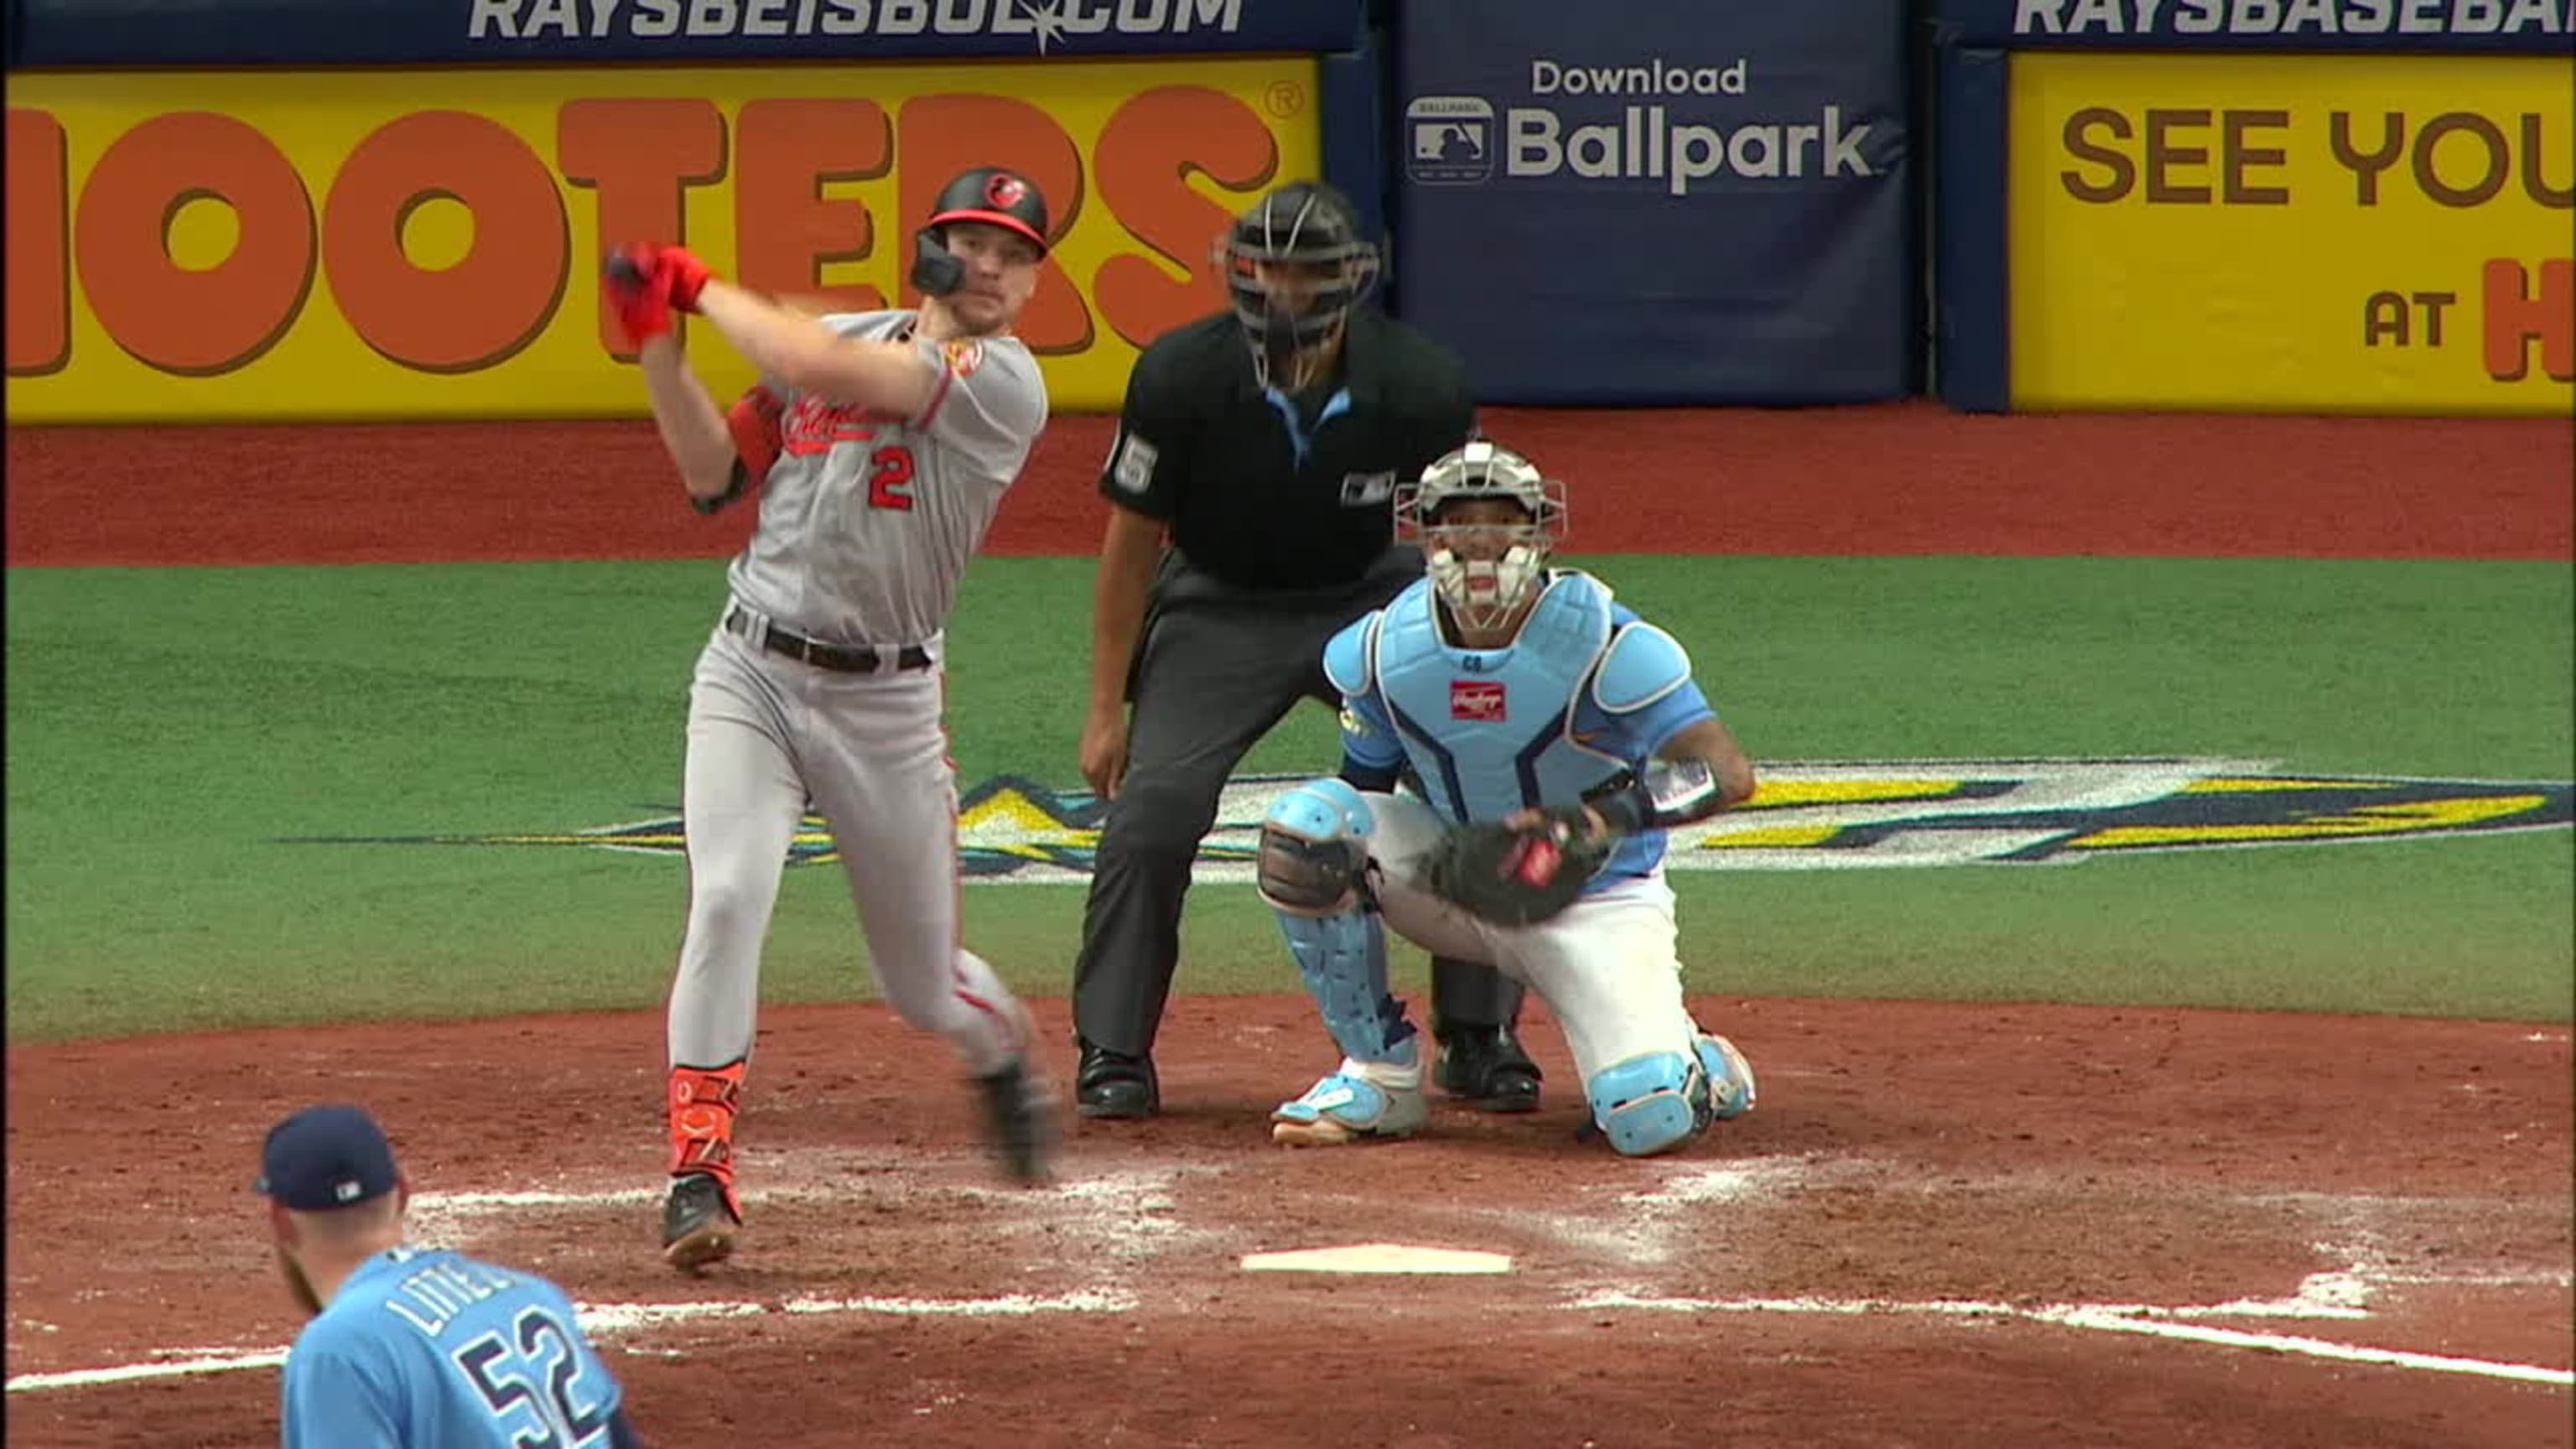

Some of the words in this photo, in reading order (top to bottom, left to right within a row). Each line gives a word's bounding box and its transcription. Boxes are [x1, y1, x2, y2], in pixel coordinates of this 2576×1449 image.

[2014, 0, 2574, 34] RAYSBASEBA
[1532, 60, 1746, 94] Download
[1507, 106, 1872, 195] Ballpark
[2060, 107, 2289, 205] SEE
[2365, 291, 2455, 346] AT
[867, 444, 914, 510] 2
[451, 1305, 608, 1449] 52
